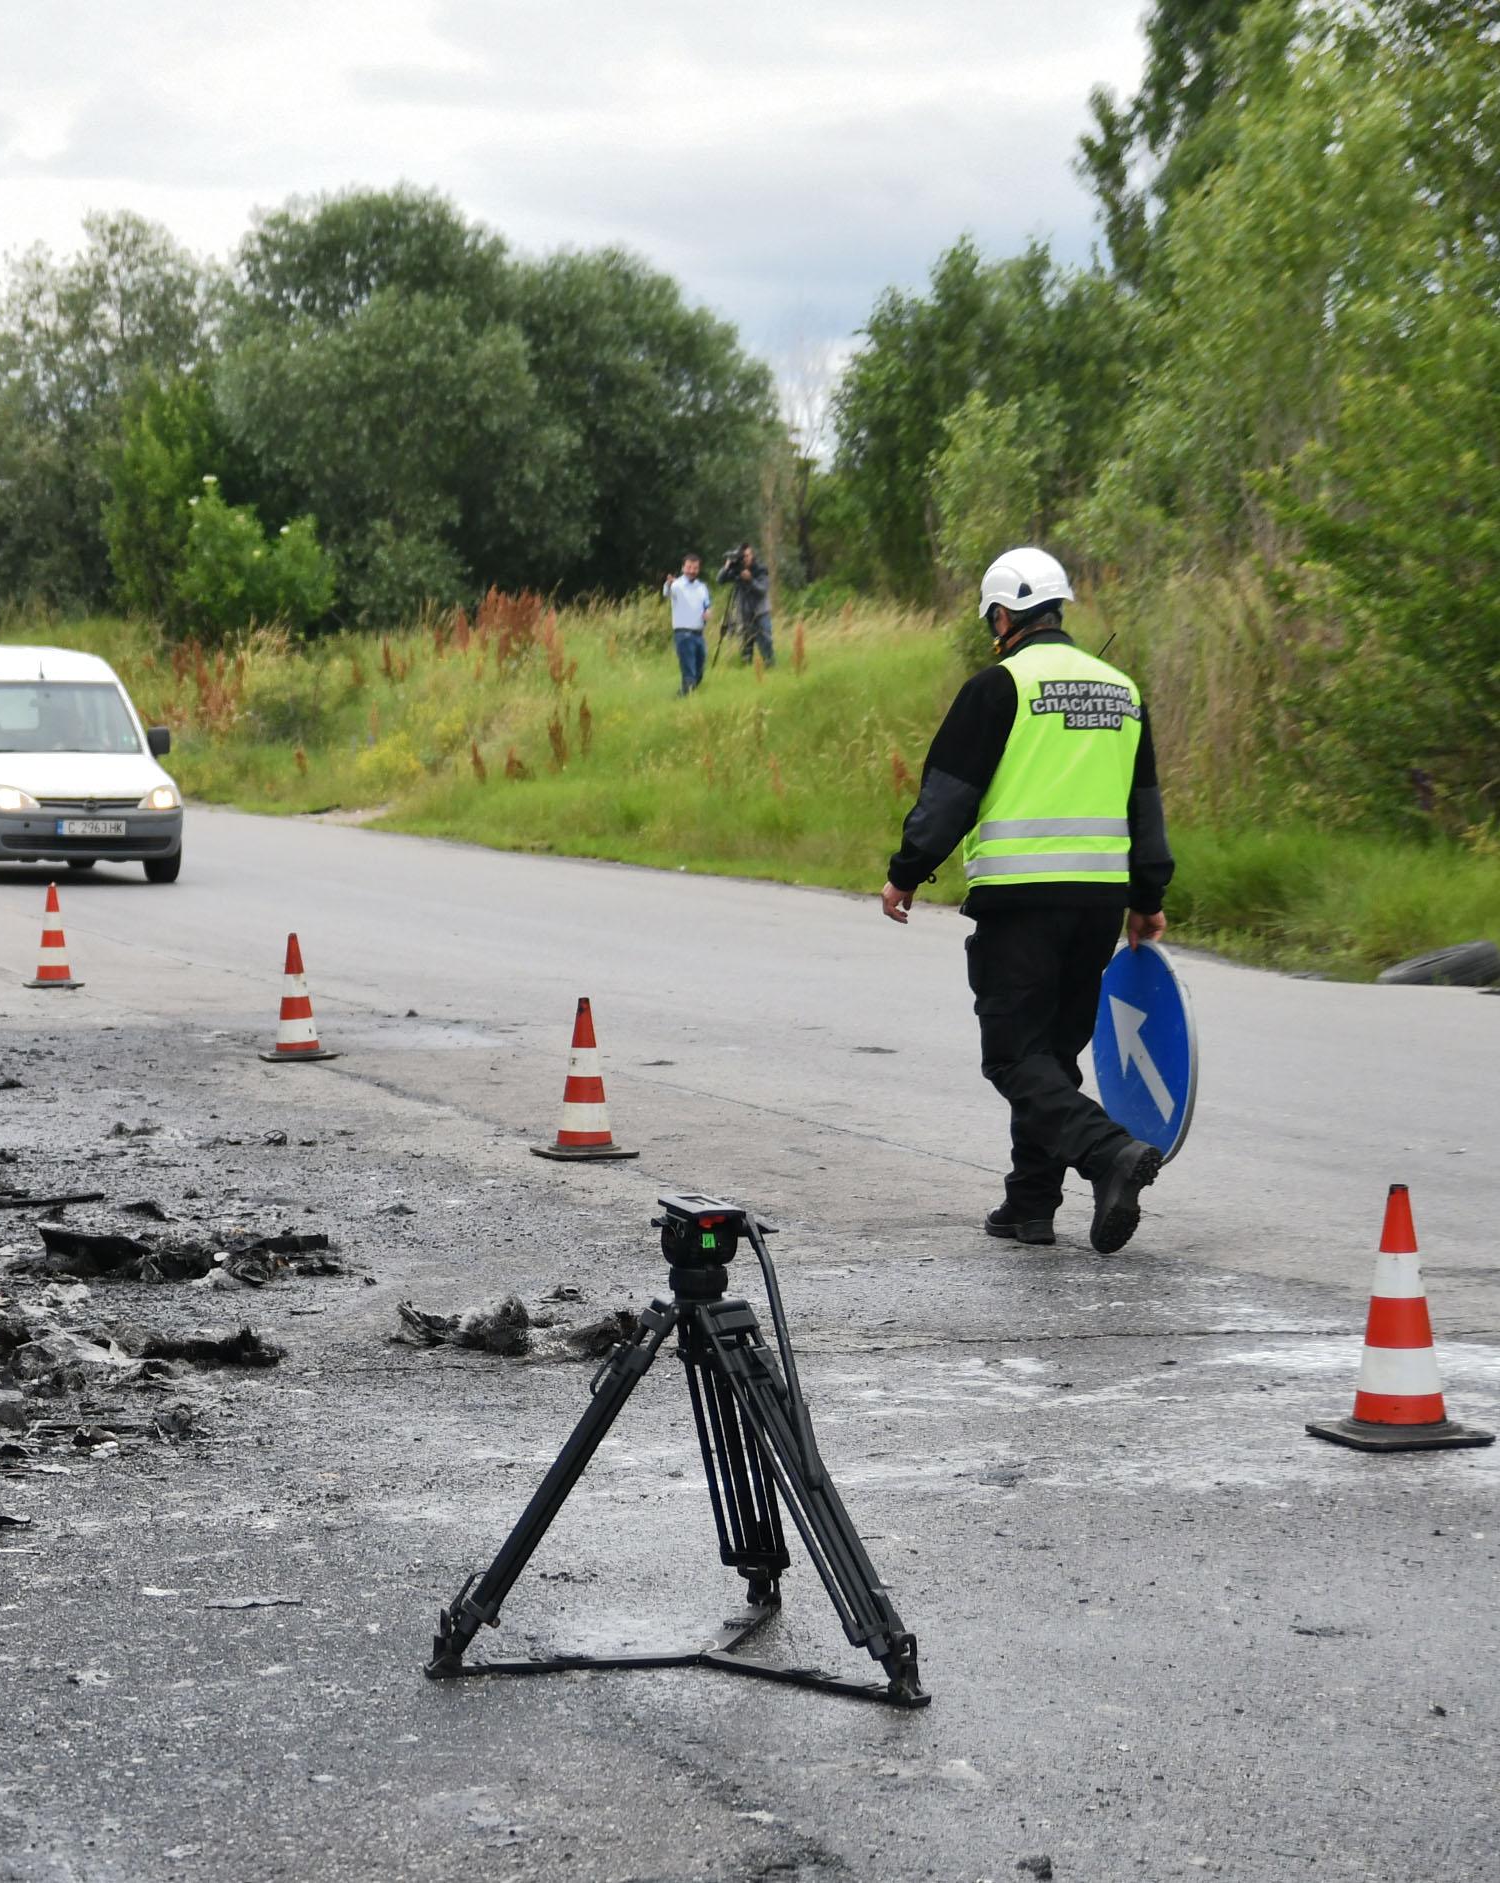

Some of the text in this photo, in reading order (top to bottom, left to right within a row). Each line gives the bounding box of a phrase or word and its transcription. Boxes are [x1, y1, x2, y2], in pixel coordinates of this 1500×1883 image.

[1043, 682, 1130, 701] АВАРИЙНО
[1032, 698, 1140, 719] СПАСИТЕЛНО
[1066, 713, 1121, 728] ЗВЕНО
